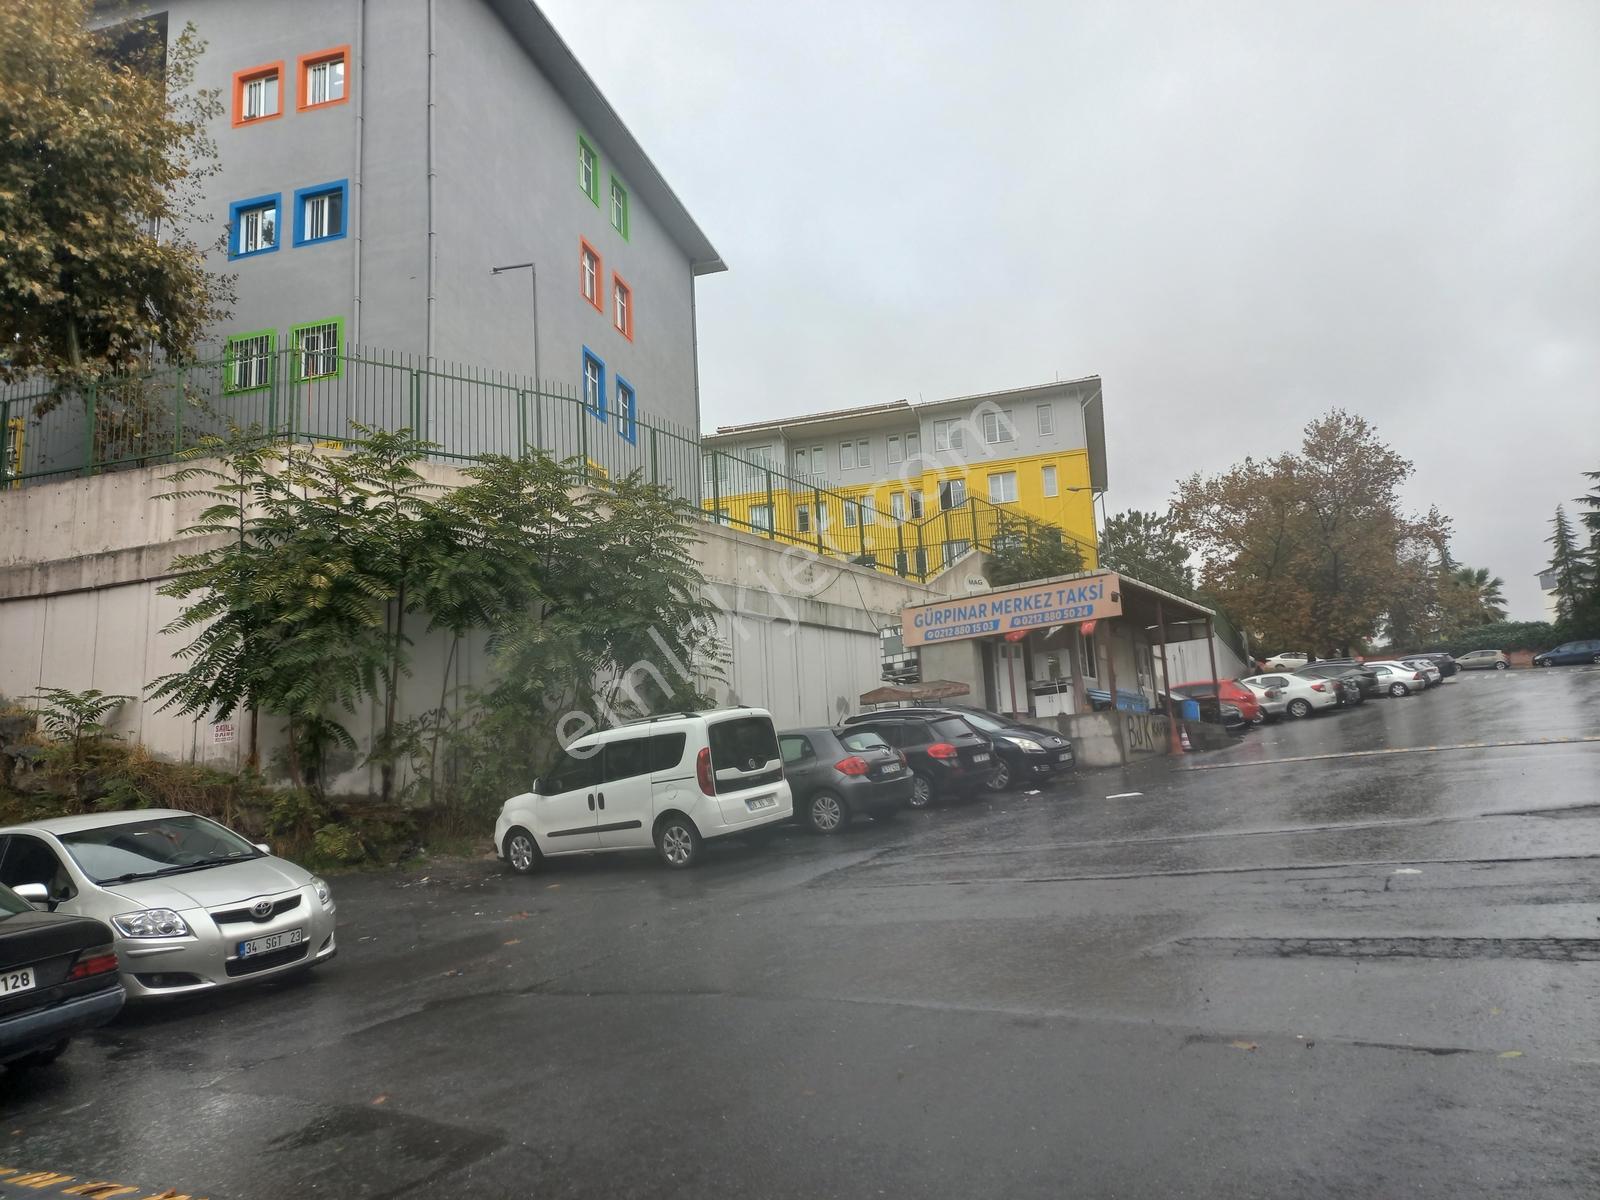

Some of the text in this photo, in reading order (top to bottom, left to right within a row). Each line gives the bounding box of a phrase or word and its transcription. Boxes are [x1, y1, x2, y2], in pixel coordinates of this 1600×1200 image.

[914, 579, 1104, 628] GÜRPINAR MERKEZ TAKSİ
[1022, 606, 1089, 625] 0212 880 50 24
[934, 621, 994, 639] 0212 880 15 03
[1128, 715, 1154, 750] BJK
[246, 942, 257, 954] 34
[265, 935, 282, 950] SGT
[290, 930, 301, 943] 23
[1, 972, 30, 991] 128
